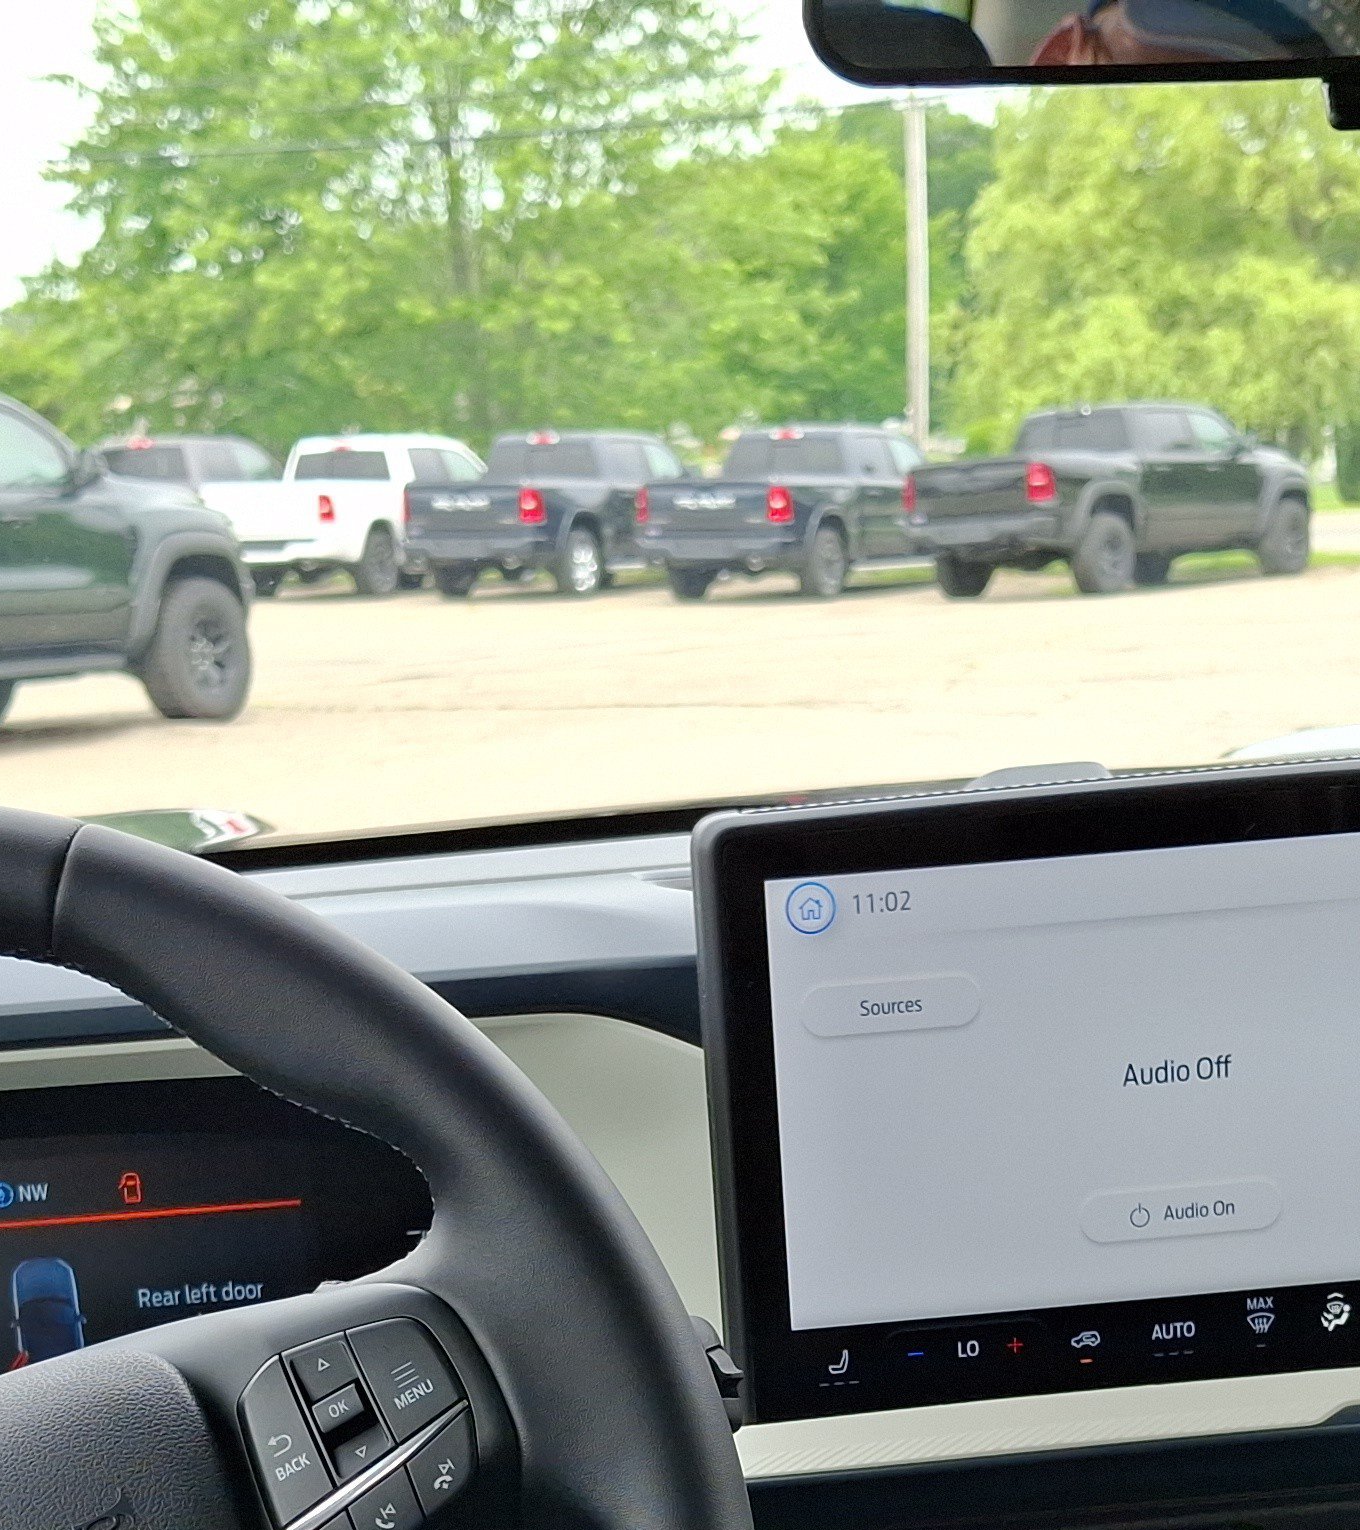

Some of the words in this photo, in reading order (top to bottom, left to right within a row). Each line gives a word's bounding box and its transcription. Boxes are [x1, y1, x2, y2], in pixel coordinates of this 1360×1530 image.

[852, 891, 911, 914] 11:02
[859, 1000, 923, 1016] Sources
[1123, 1059, 1190, 1087] Audio
[1196, 1054, 1232, 1080] Off
[18, 1183, 49, 1202] NW
[1164, 1203, 1209, 1220] Audio
[1213, 1200, 1235, 1217] On
[138, 1286, 180, 1309] Rear
[185, 1282, 218, 1303] left
[221, 1280, 263, 1303] door
[1246, 1296, 1274, 1311] MAX
[1151, 1321, 1196, 1341] AUTO
[957, 1340, 980, 1358] LO
[393, 1378, 434, 1411] MENU
[328, 1399, 349, 1418] OK
[274, 1453, 311, 1482] BACK
